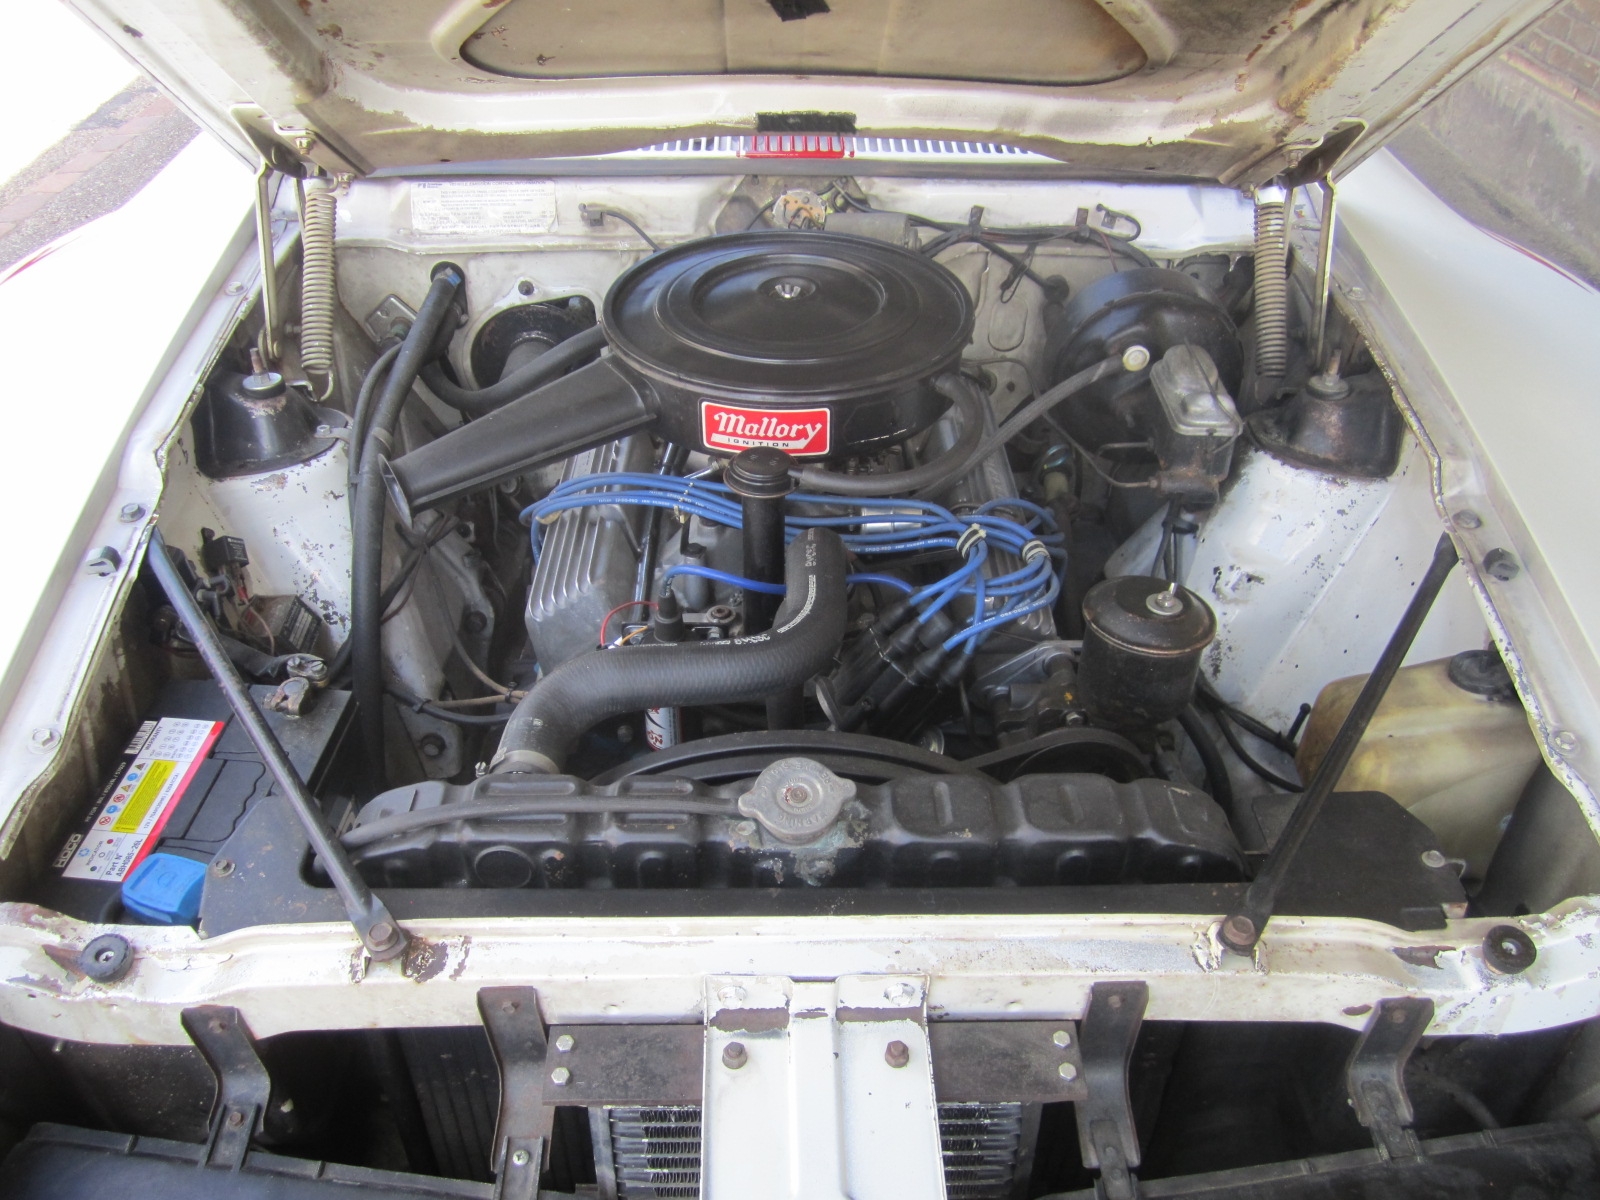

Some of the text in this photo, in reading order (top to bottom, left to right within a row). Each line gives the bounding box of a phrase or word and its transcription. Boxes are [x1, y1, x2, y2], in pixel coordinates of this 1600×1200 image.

[713, 411, 823, 440] Mallory
[727, 438, 790, 447] IGNITION
[144, 725, 163, 750] WARRANTY
[104, 861, 119, 875] Part
